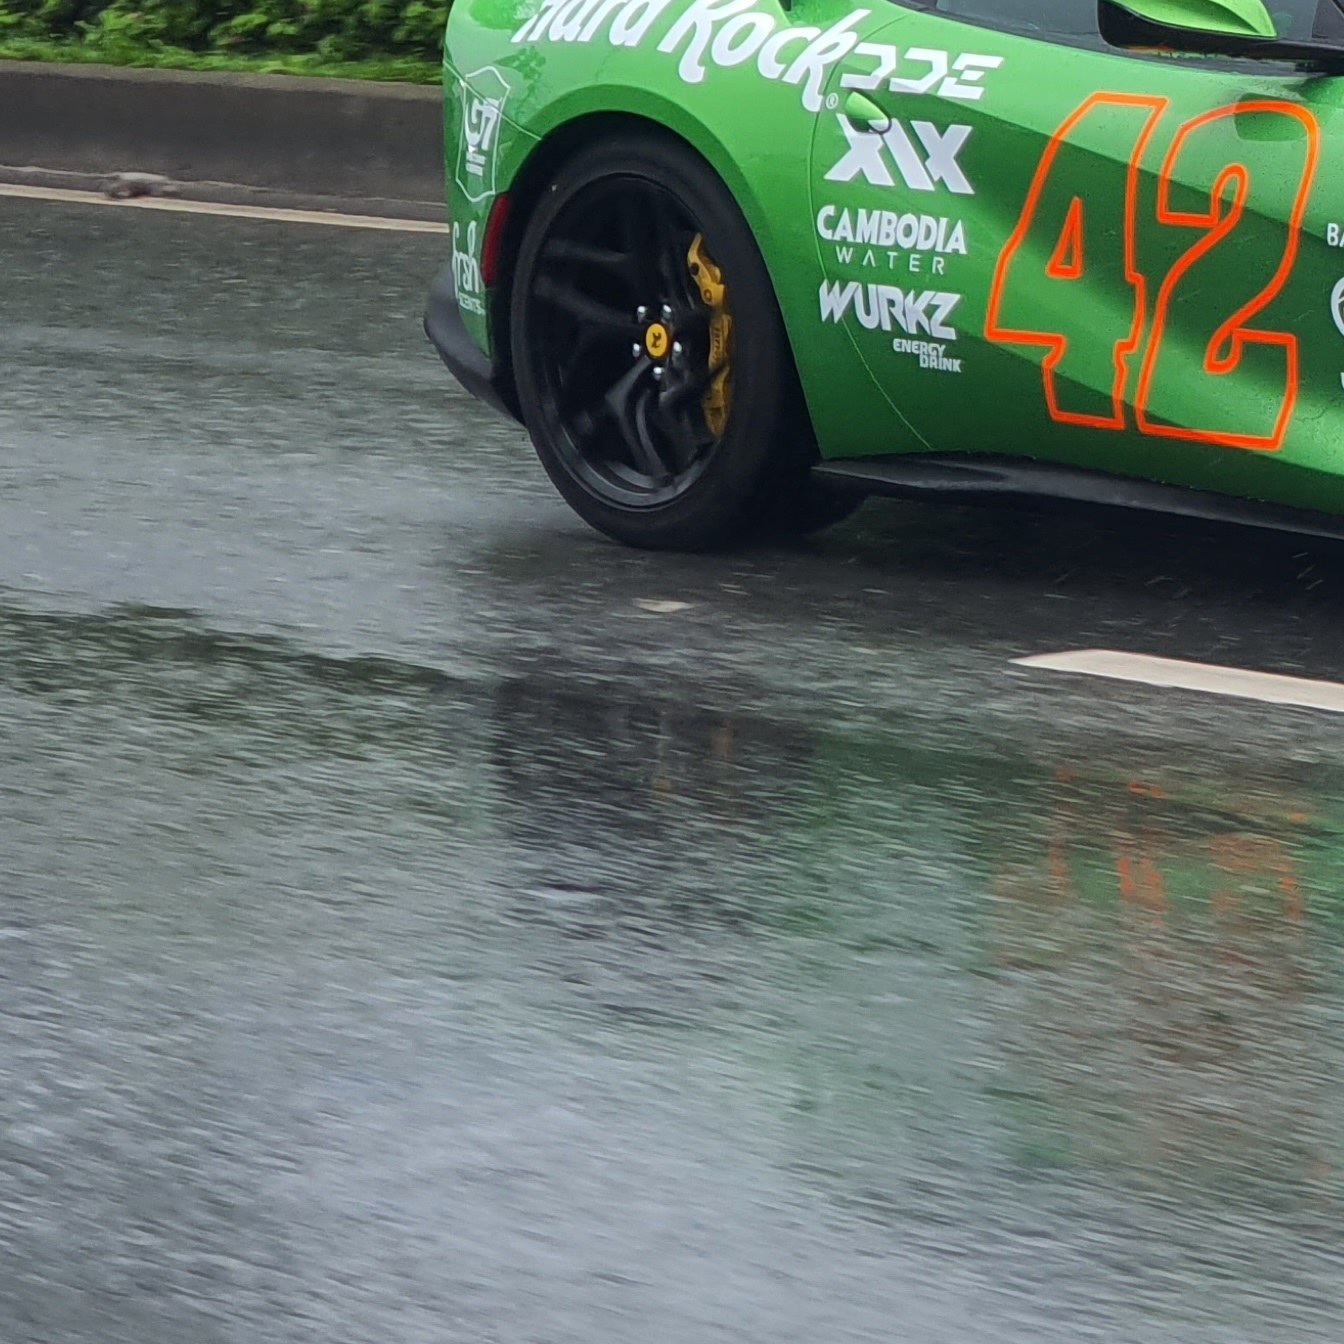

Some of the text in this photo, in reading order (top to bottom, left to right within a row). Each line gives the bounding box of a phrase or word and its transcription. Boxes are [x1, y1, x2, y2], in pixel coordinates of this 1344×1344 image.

[816, 204, 968, 255] CAMBODIA
[835, 245, 945, 276] WATER
[984, 90, 1320, 453] 42
[819, 278, 961, 341] WURKZ
[892, 338, 946, 359] ENERGY
[919, 355, 962, 373] DRINK
